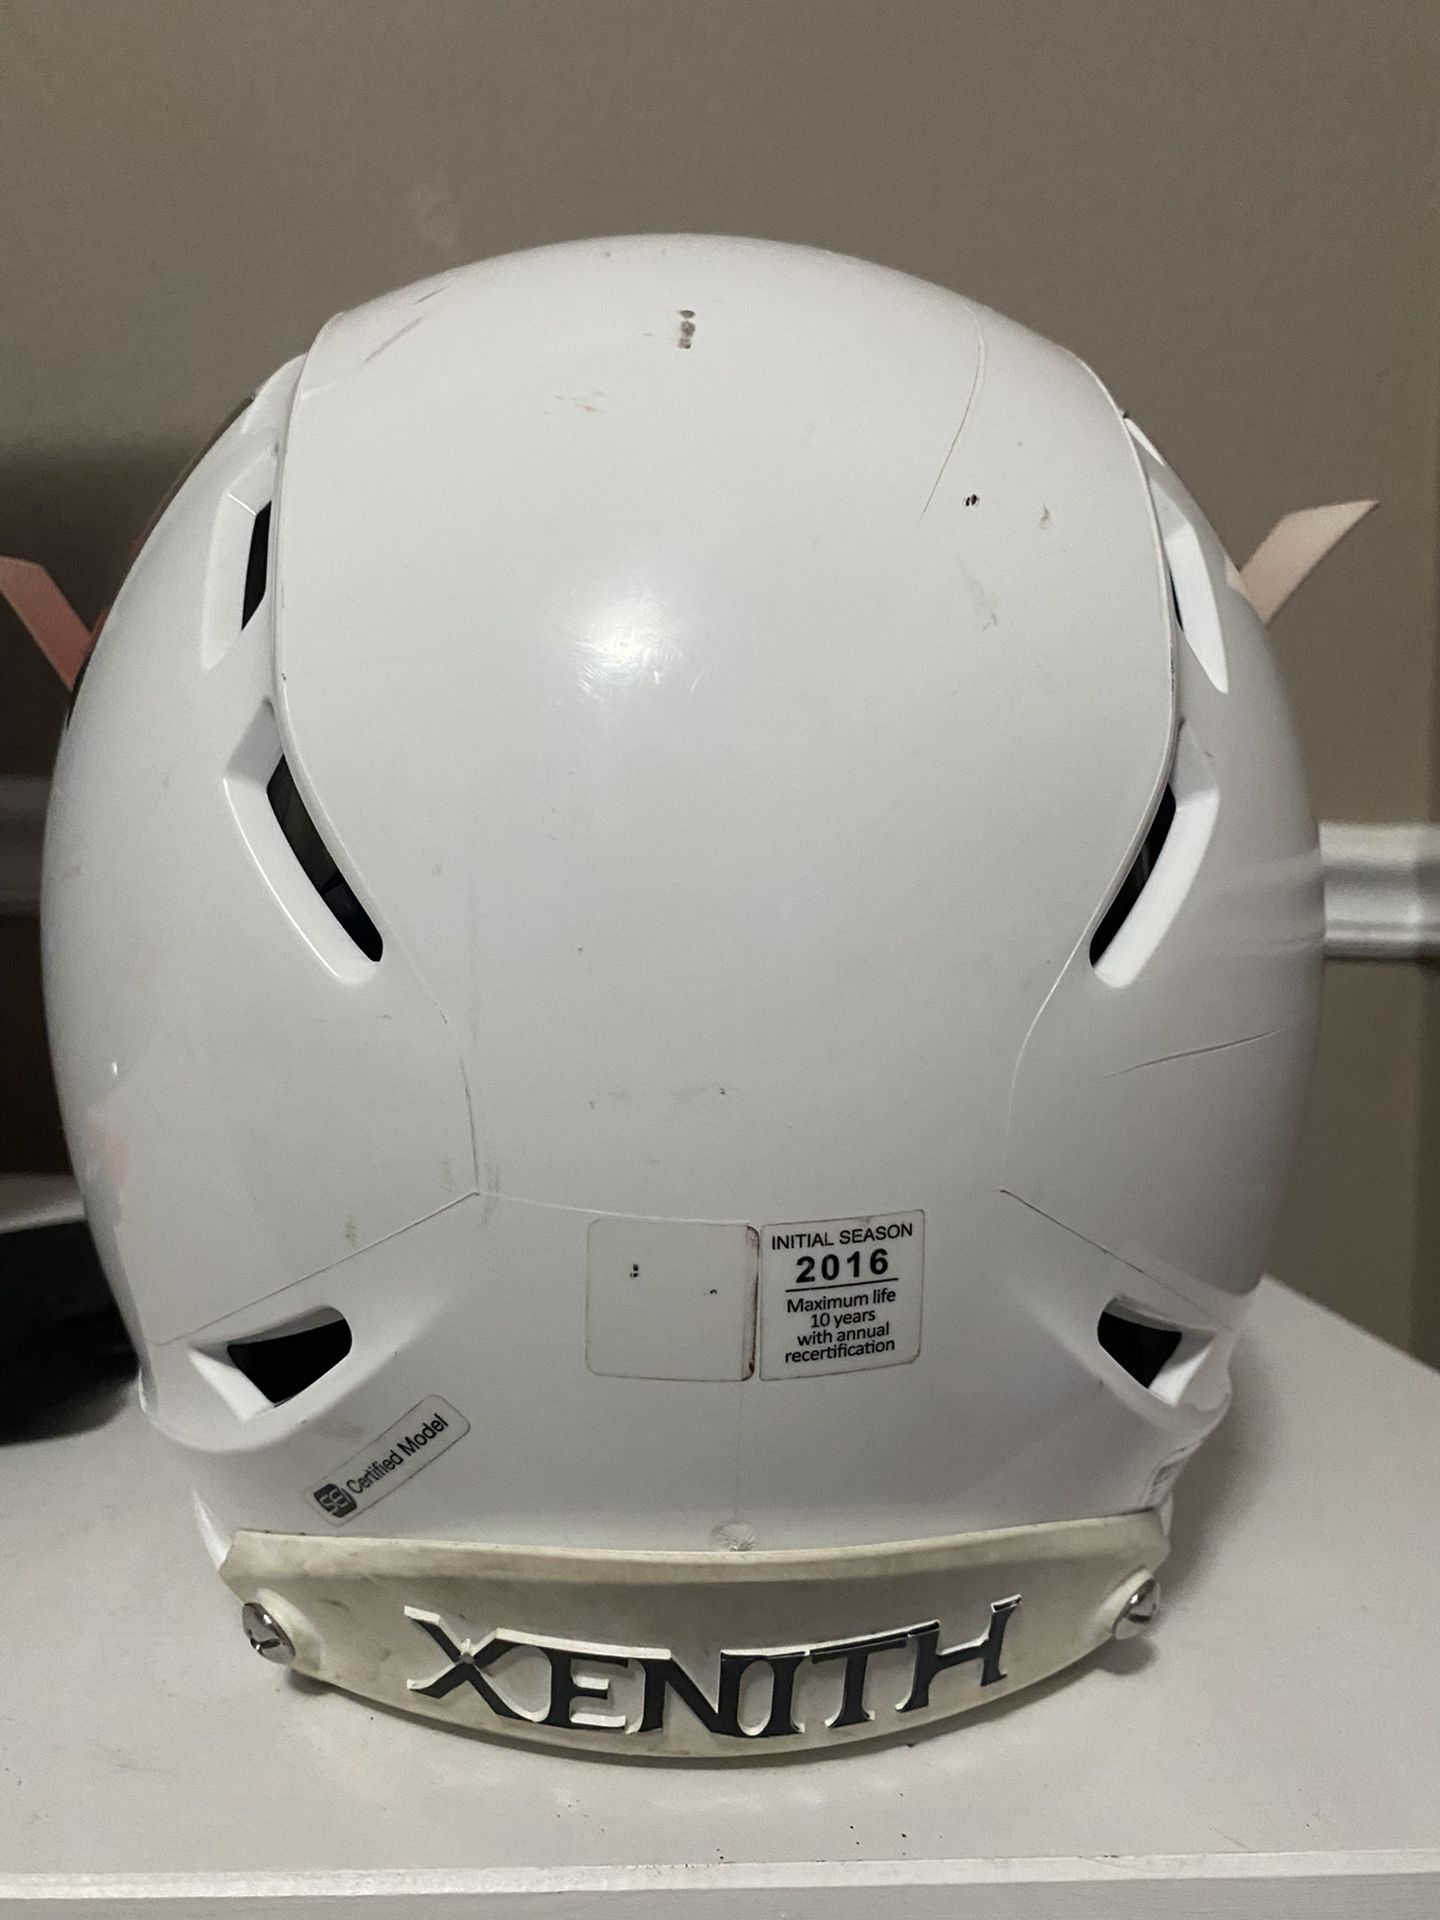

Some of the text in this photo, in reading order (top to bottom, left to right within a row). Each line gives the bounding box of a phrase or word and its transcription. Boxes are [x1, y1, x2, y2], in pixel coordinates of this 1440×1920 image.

[771, 1223, 913, 1250] INITIAL SEASON
[796, 1248, 889, 1283] 2016
[787, 1288, 896, 1313] Maximum life
[810, 1309, 876, 1329] 10 years
[797, 1321, 890, 1346] with annual
[785, 1339, 895, 1363] recertification
[345, 1450, 404, 1494] Certified
[397, 1413, 449, 1456] Model
[403, 1594, 1022, 1739] XENITH
